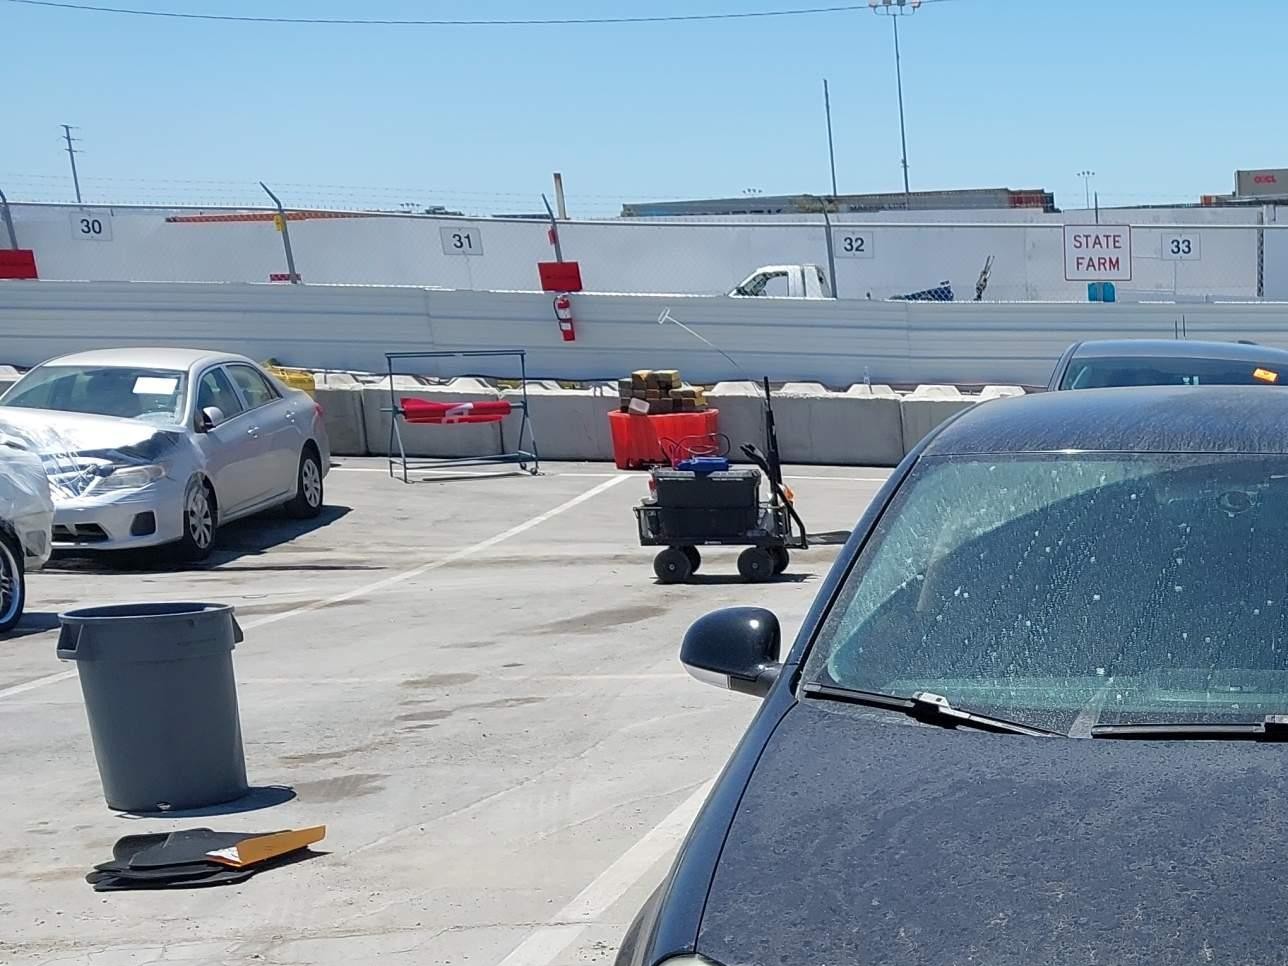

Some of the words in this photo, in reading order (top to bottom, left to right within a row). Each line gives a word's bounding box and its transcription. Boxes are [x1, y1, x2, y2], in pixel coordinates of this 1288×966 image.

[80, 218, 102, 234] 30
[452, 233, 472, 249] 31
[843, 236, 865, 252] 32
[1073, 234, 1122, 249] STATE
[1170, 239, 1191, 254] 33
[1076, 256, 1120, 271] FARM
